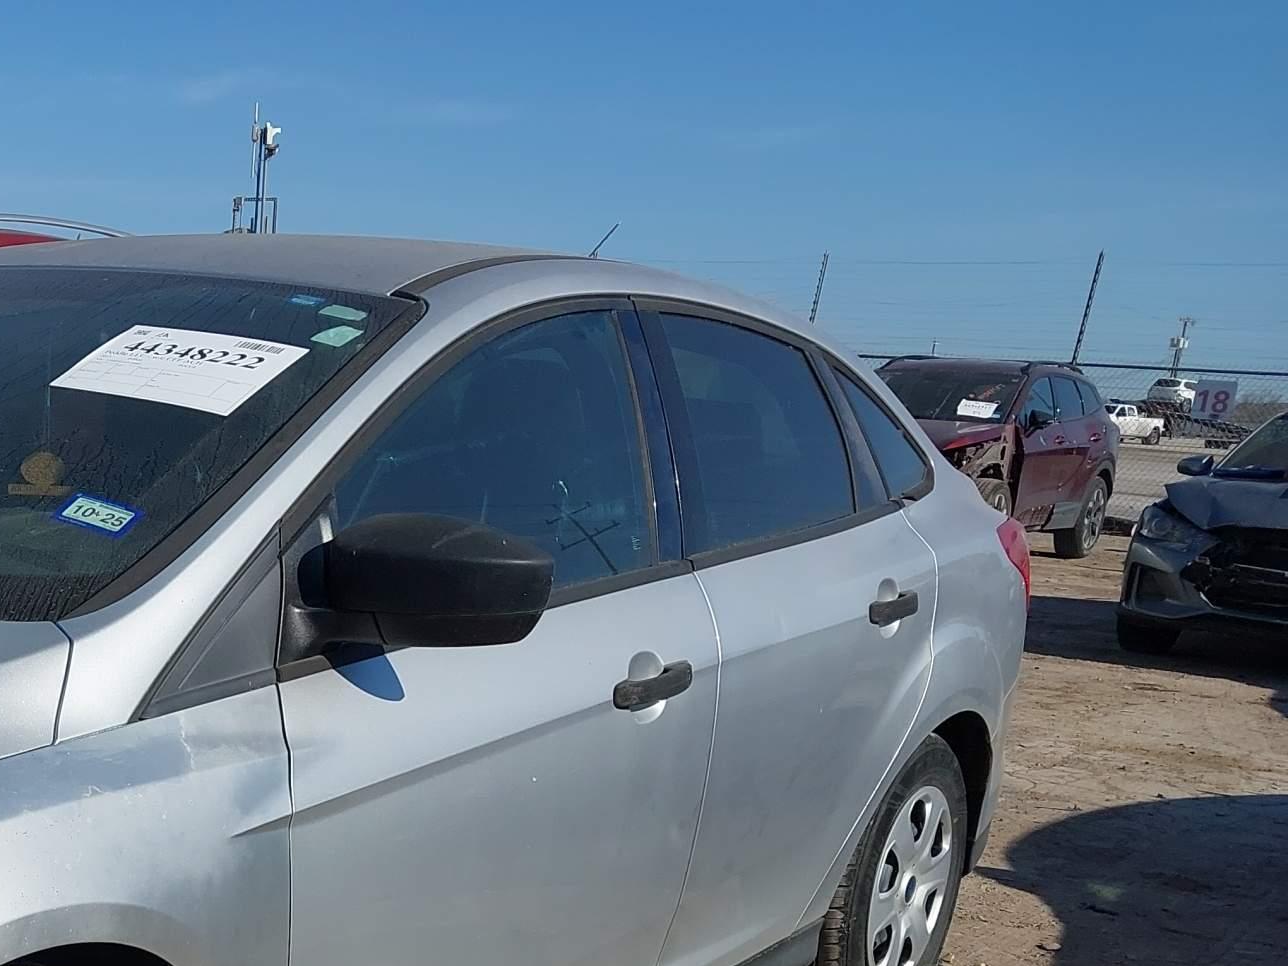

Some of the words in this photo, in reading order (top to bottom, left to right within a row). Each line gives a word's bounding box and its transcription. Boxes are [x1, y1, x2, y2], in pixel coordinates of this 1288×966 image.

[123, 340, 266, 370] 44348222
[1198, 389, 1230, 413] 18
[73, 504, 97, 518] 10
[99, 512, 128, 527] 25
